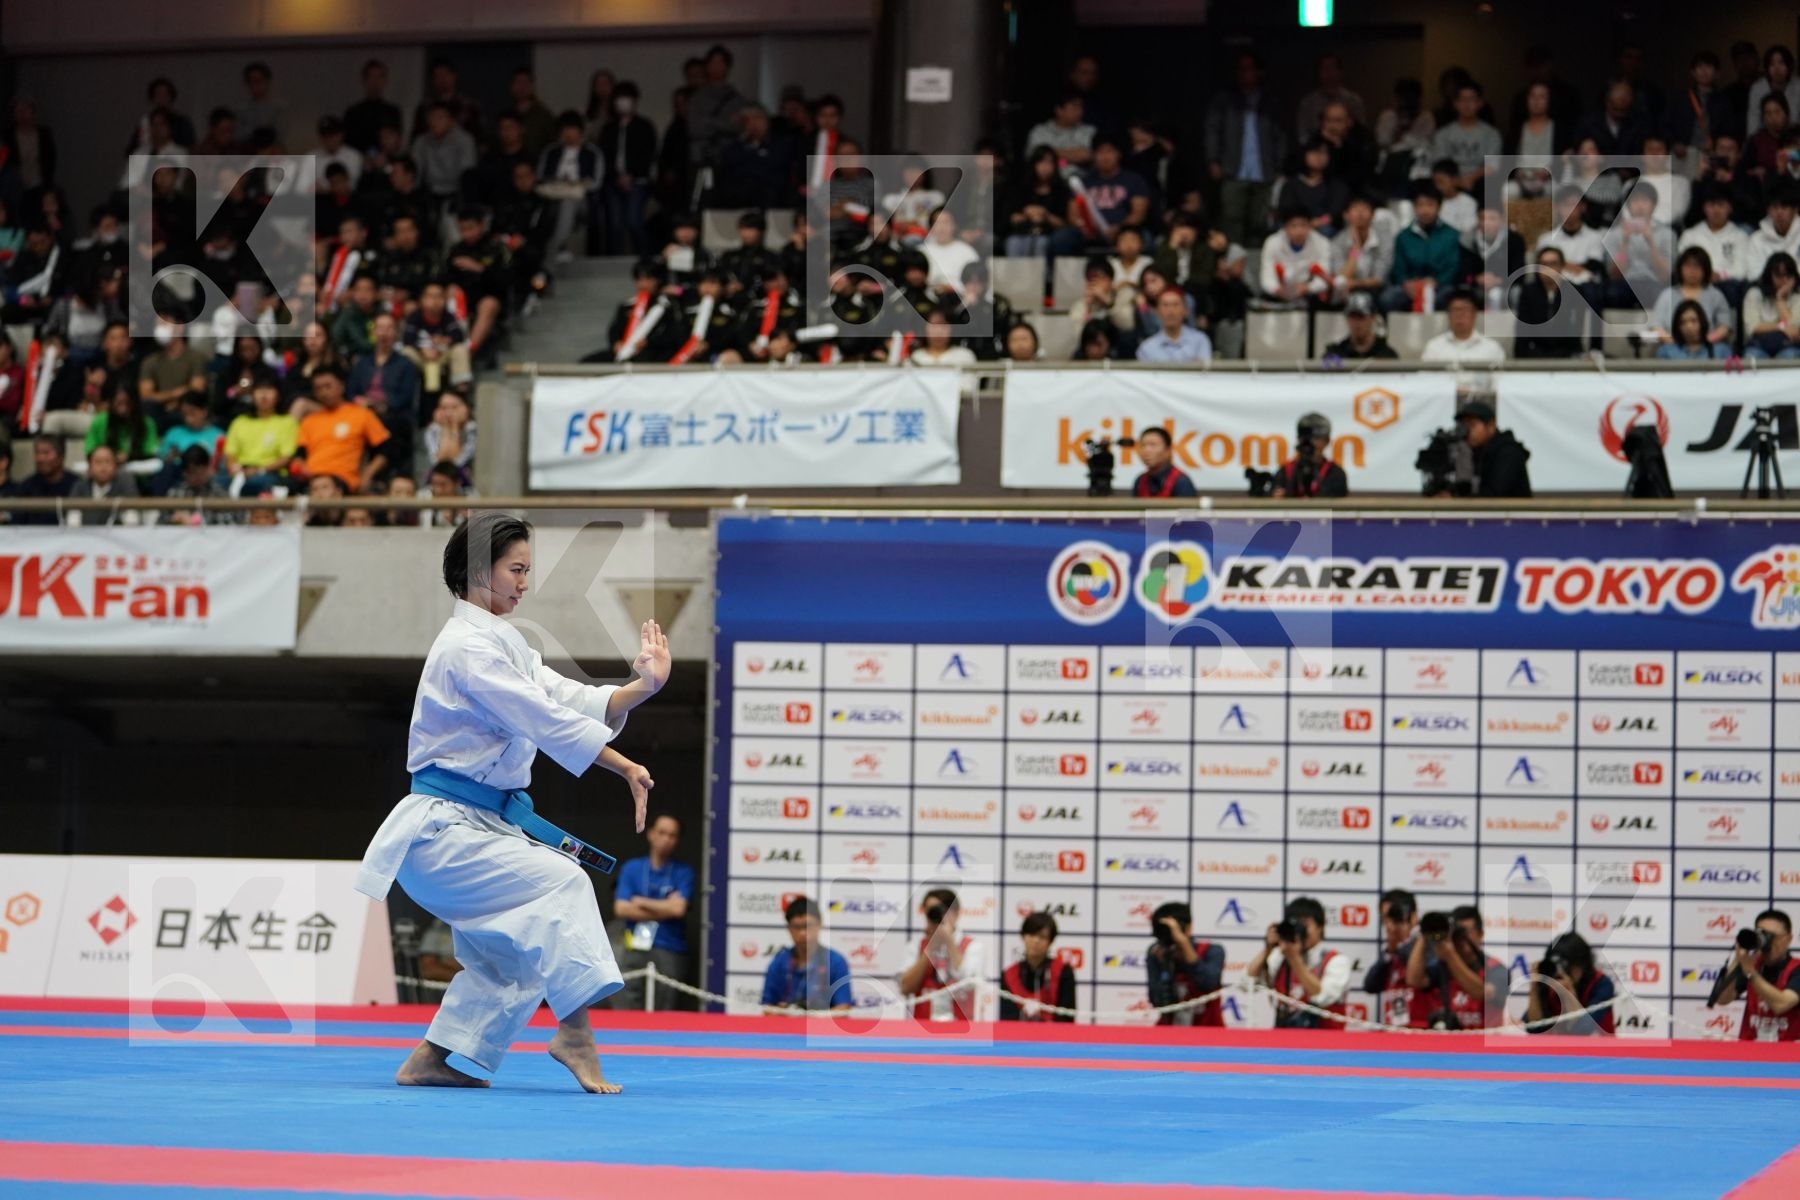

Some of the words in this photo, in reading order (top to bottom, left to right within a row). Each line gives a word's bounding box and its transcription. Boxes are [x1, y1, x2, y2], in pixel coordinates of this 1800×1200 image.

[564, 410, 632, 454] FSK
[639, 410, 926, 448] 富士スポーツ工業
[1521, 566, 1717, 606] TOKYO
[93, 577, 209, 618] Fan
[1222, 593, 1345, 605] PREMIER
[1355, 594, 1467, 606] LEAGUE
[768, 659, 809, 672] JAL
[1326, 665, 1369, 679] JAL
[1703, 671, 1763, 684] ALSOK
[1043, 710, 1084, 724] JAL
[1410, 717, 1469, 730] ALSOK
[1488, 719, 1562, 733] kikkoman
[1615, 717, 1659, 732] JAL
[766, 754, 807, 768] JAL
[1324, 762, 1367, 776] JAL
[1701, 770, 1762, 783] ALSOK
[1041, 806, 1082, 820] JAL
[1408, 815, 1467, 828] ALSOK
[1486, 817, 1560, 831] kikkoman
[1613, 816, 1657, 831] JAL
[764, 849, 805, 863] JAL
[1322, 860, 1365, 874] JAL
[1699, 869, 1760, 883] ALSOK
[1612, 915, 1656, 930] JAL
[155, 909, 336, 952] 日本生命
